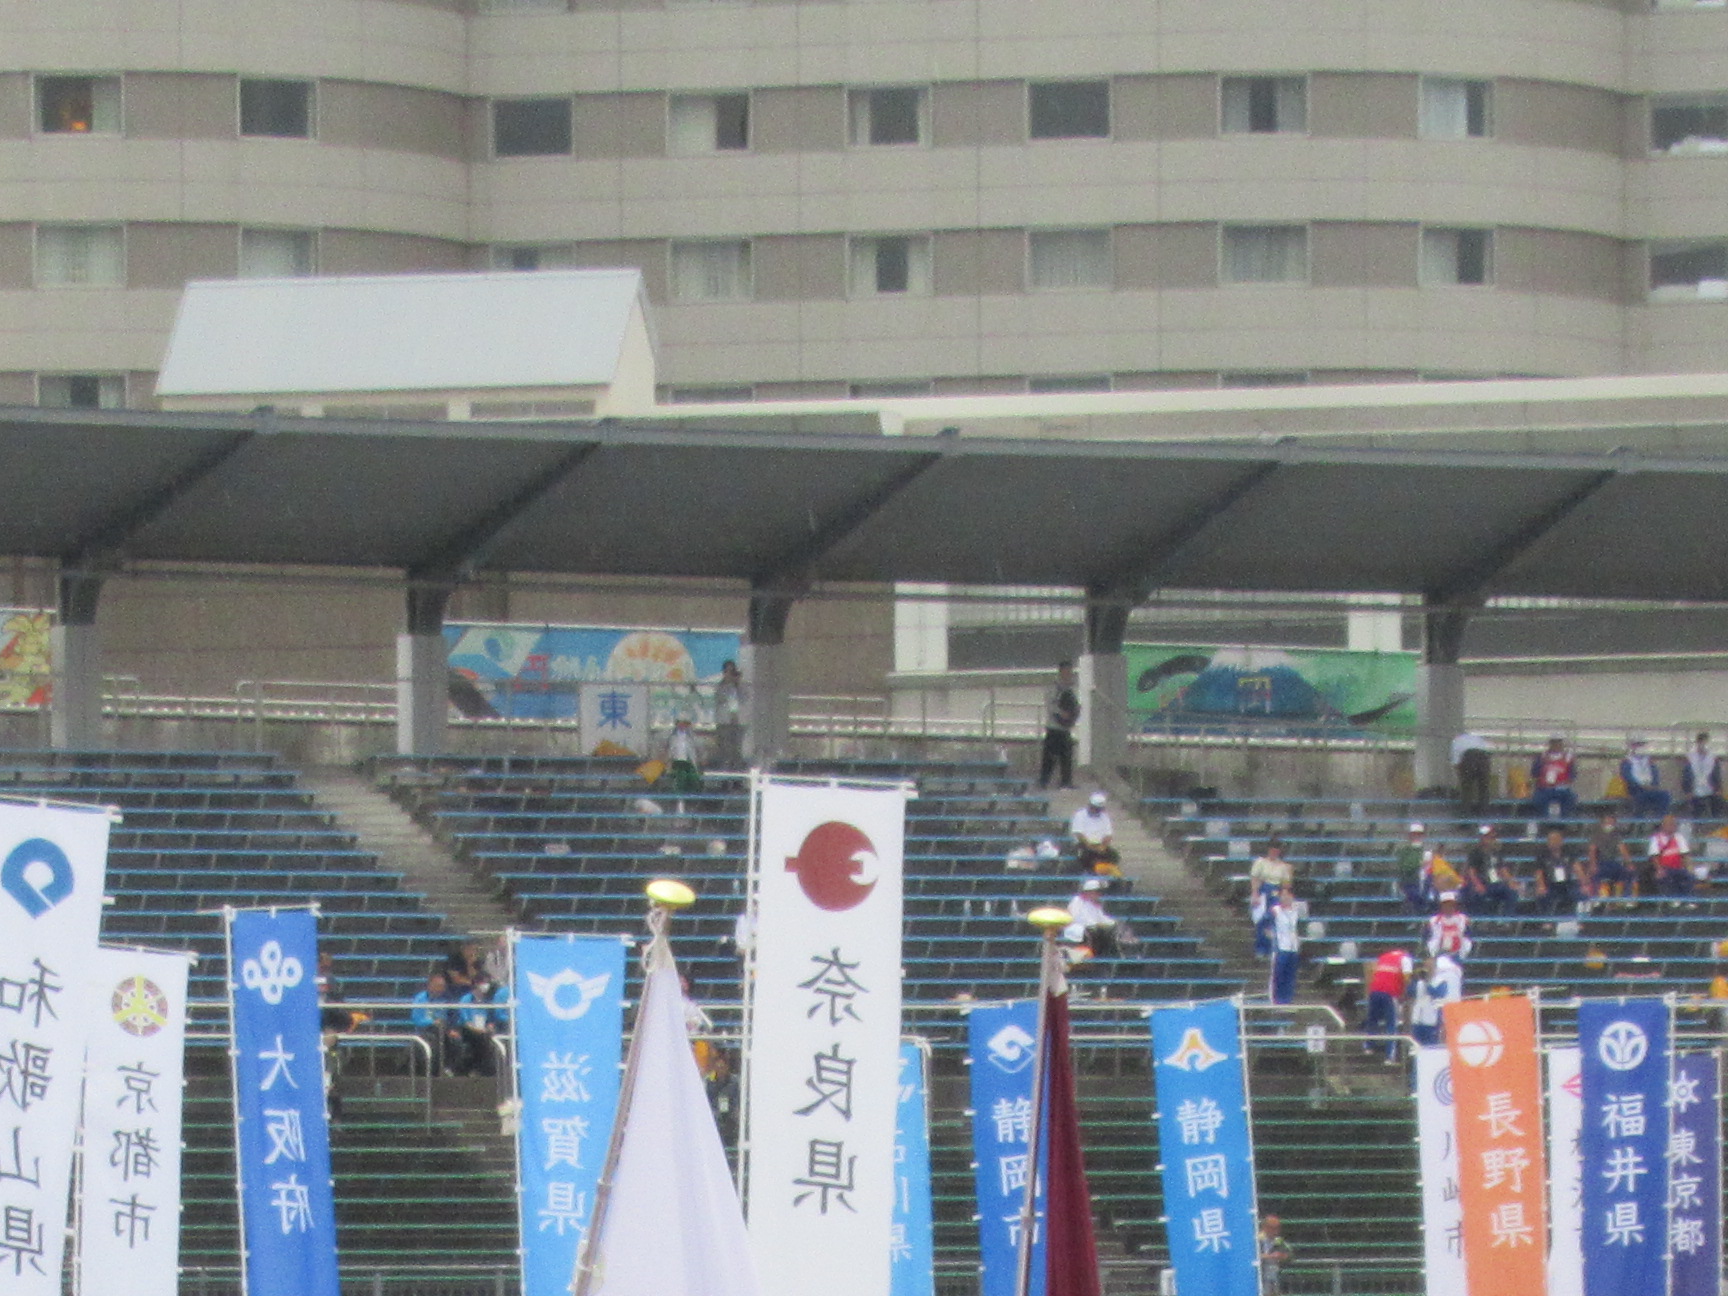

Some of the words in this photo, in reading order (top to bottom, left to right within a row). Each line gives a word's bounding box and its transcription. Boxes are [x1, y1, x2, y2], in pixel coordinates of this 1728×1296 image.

[597, 690, 632, 730] 東
[992, 1097, 1044, 1246] 静岡市
[1177, 1097, 1233, 1254] 静岡県
[1478, 1091, 1534, 1248] 長野県
[1601, 1094, 1648, 1246] 福井県
[1663, 1129, 1705, 1255] 東京都
